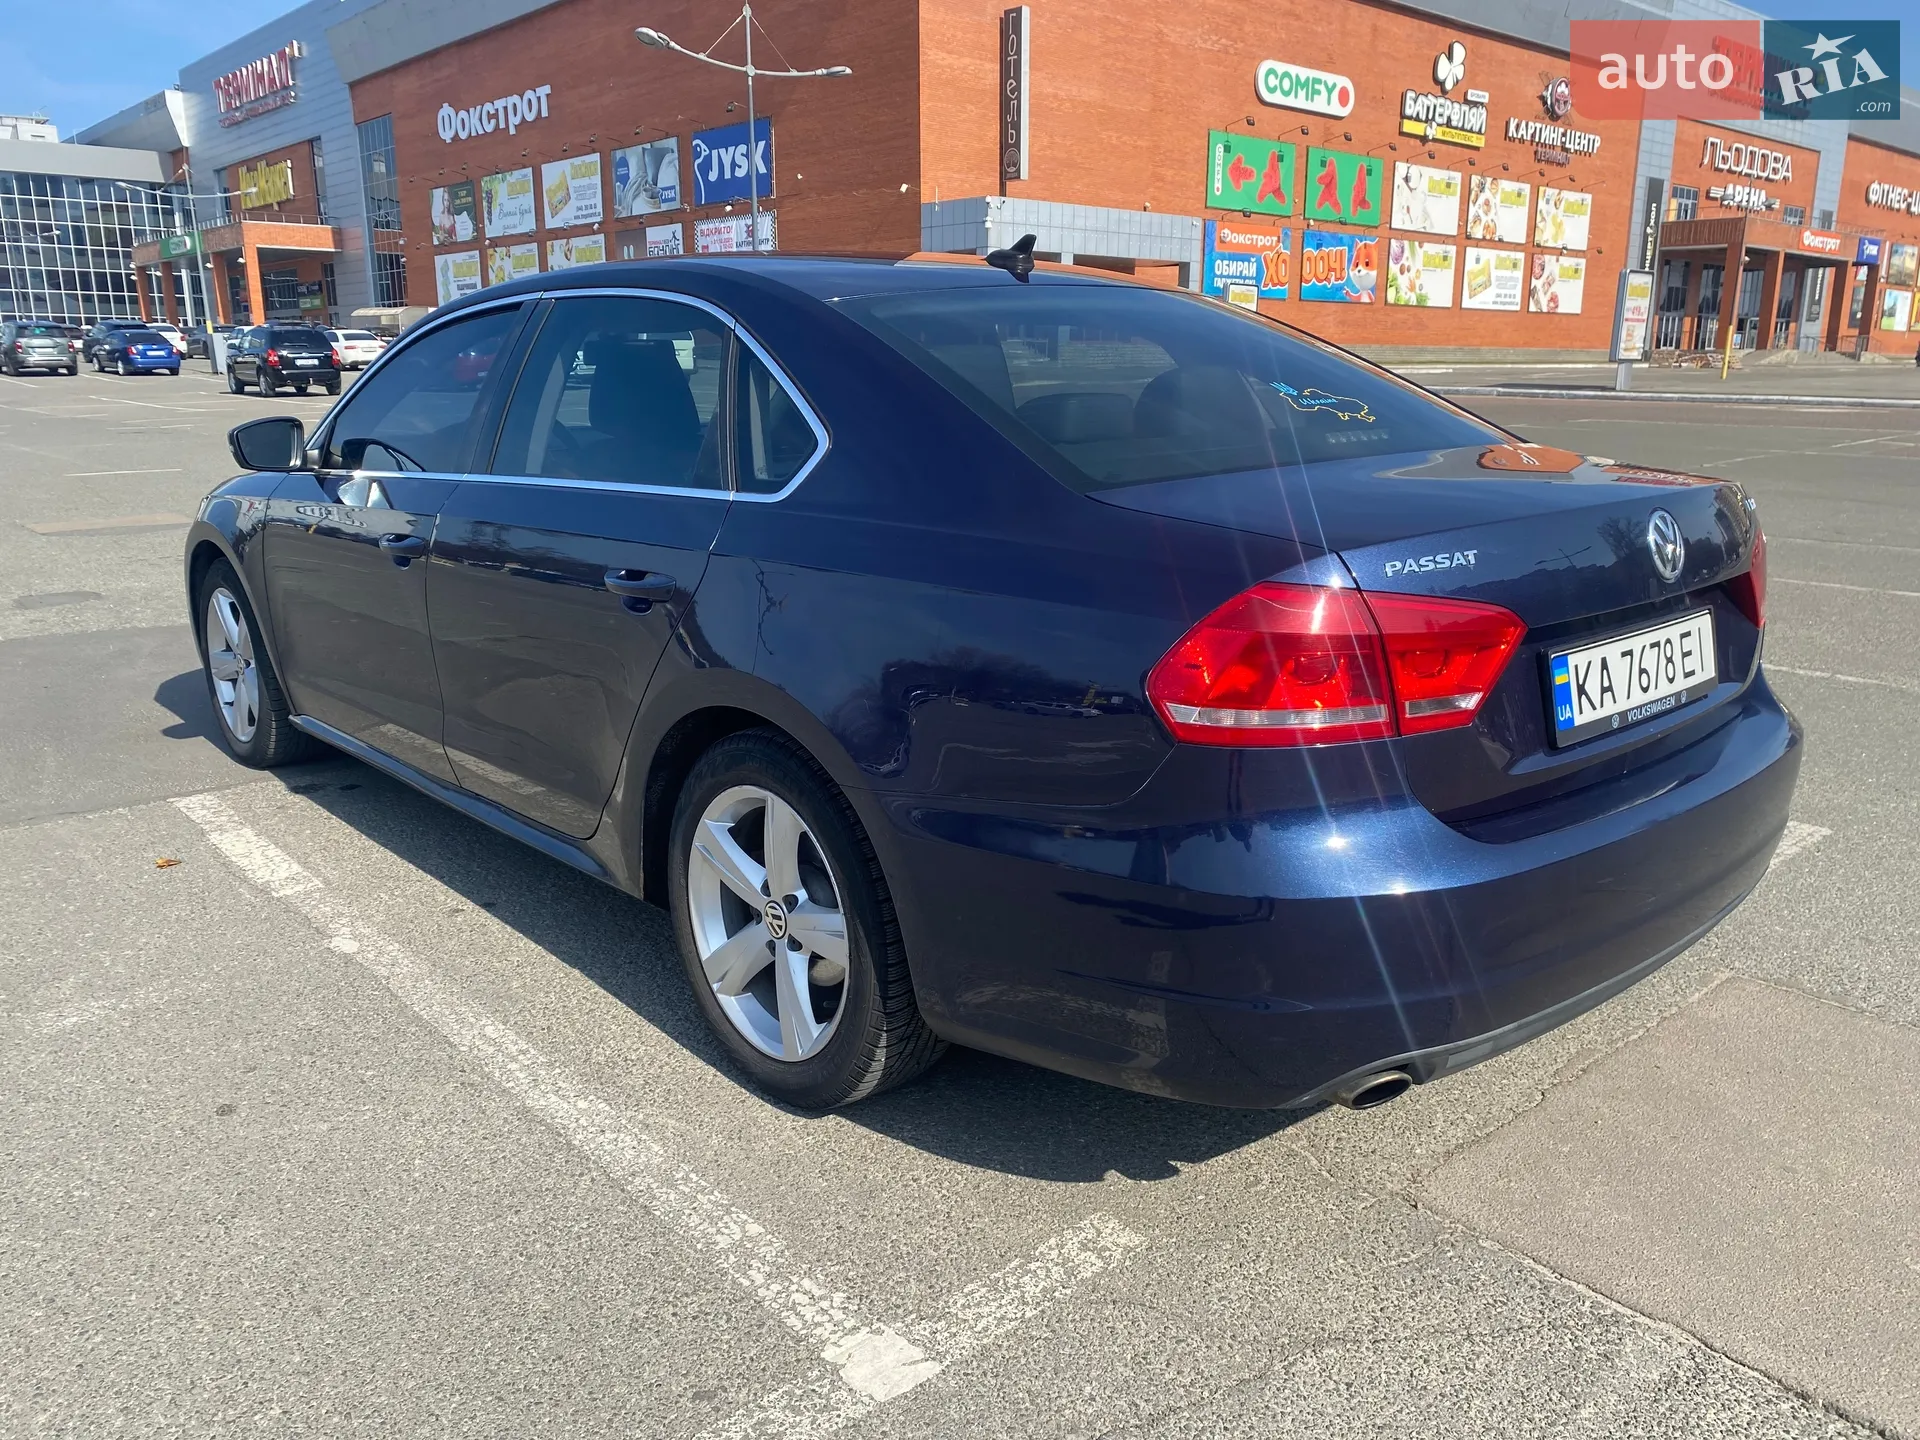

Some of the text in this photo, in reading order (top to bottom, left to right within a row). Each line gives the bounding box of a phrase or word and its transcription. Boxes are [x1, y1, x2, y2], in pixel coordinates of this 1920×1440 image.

[1264, 67, 1337, 106] COMFY
[437, 84, 552, 143] Фокстрот
[1404, 89, 1487, 134] БАТТЕРФЛЯЙ
[1507, 117, 1602, 154] КАРТИНГ-ЦЕНТР
[708, 140, 767, 182] JYSK
[1703, 137, 1792, 182] ЛЬОДОВА
[661, 188, 676, 200] JYSK
[1869, 180, 1920, 216] ФІТНЕС-Ц
[699, 225, 733, 239] ВІДКРИТО!
[1221, 228, 1278, 247] Фокстрот
[1803, 230, 1841, 252] Фокстрот
[1214, 257, 1257, 277] ОБИРАЙ
[1384, 549, 1478, 577] PASSAT
[1574, 626, 1705, 716] KA 7678 EI
[1558, 702, 1573, 722] UA
[1627, 695, 1676, 722] VOLKSWAGEN
